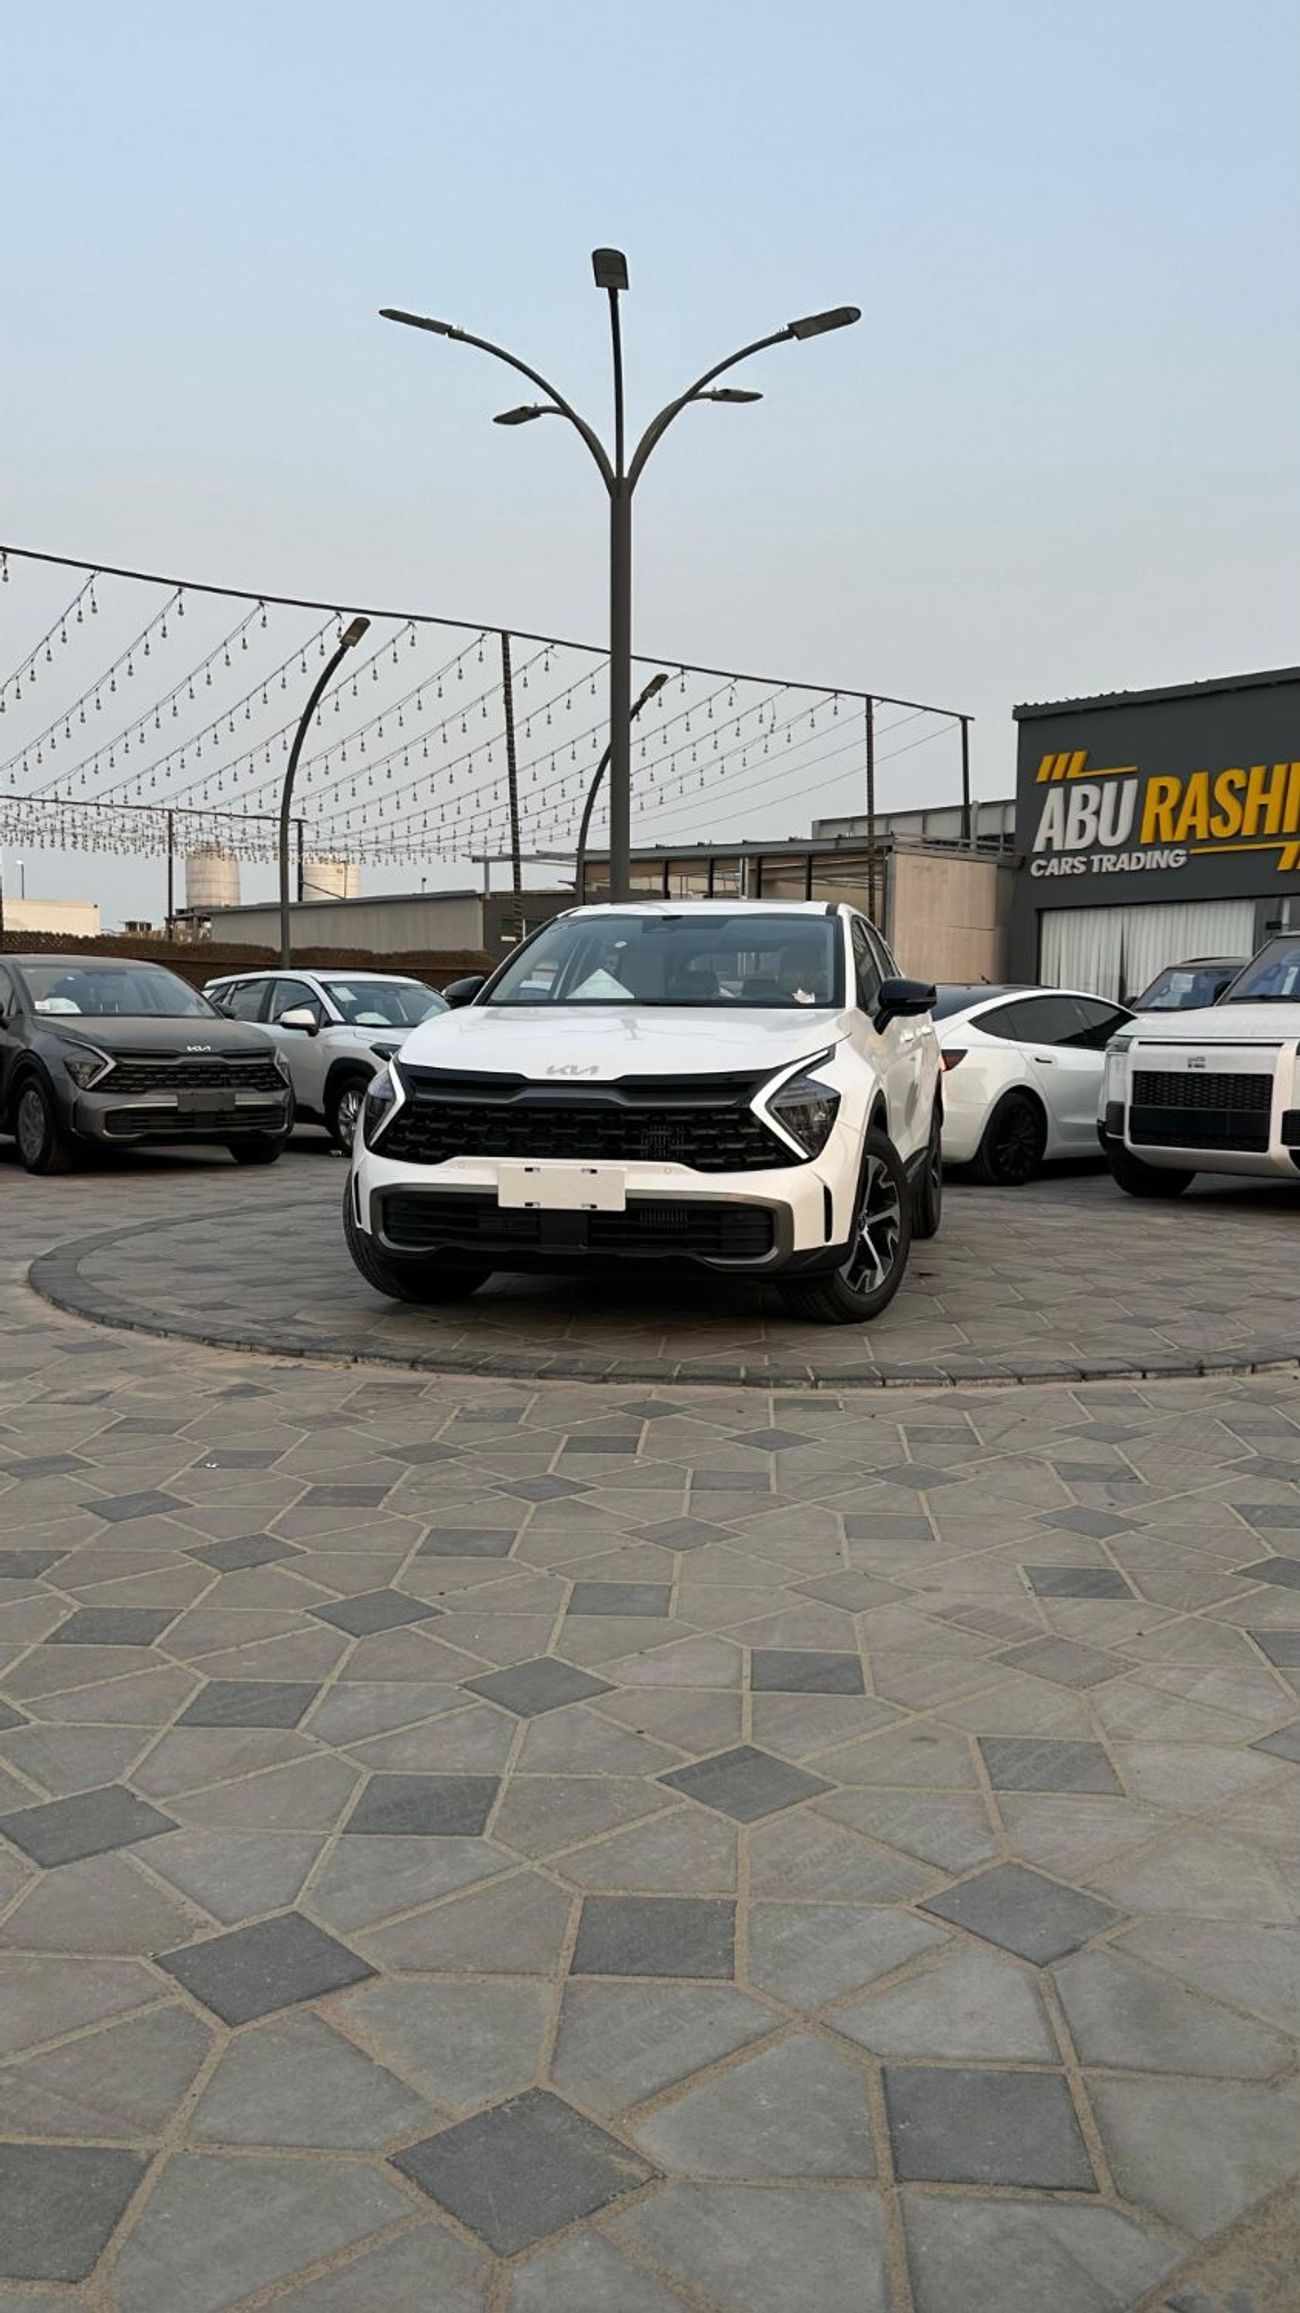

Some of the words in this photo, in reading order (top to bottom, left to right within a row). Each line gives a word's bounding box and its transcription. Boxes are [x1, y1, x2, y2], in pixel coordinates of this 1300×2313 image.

[1032, 779, 1138, 852] ABU
[1140, 762, 1300, 844] RASHI
[1030, 855, 1087, 877] CARS
[1090, 849, 1188, 873] TRADING
